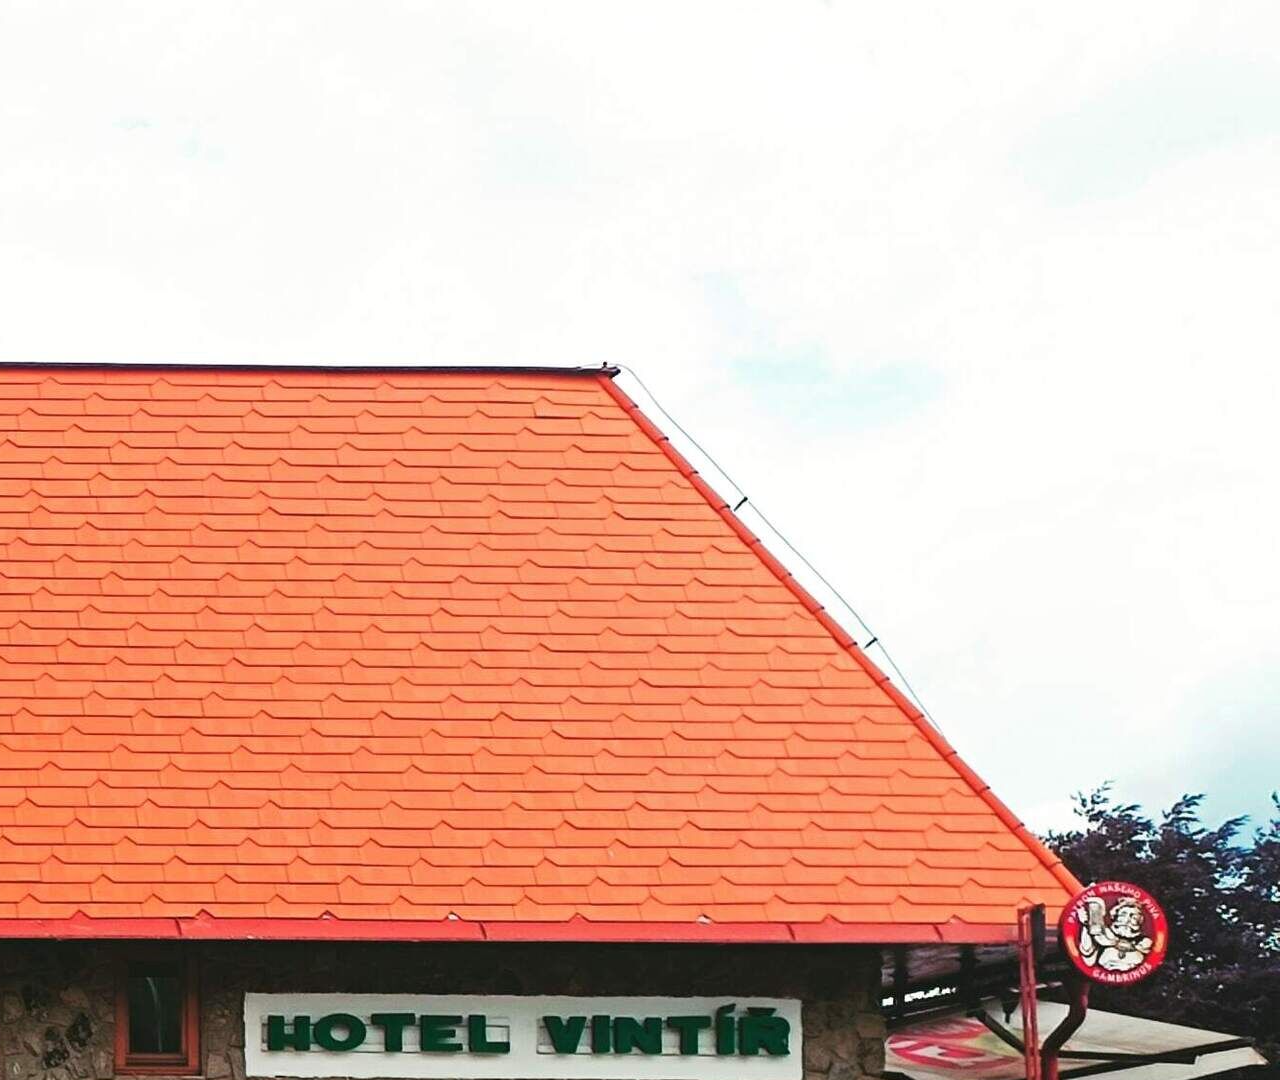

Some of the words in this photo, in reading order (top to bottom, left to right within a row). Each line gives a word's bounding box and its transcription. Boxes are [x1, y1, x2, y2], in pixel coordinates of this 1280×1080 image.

[1143, 898, 1160, 920] PIVA
[1092, 962, 1152, 982] GAMBRINUS
[267, 1013, 510, 1053] HOTEL
[543, 1003, 791, 1056] VINTÍŘ
